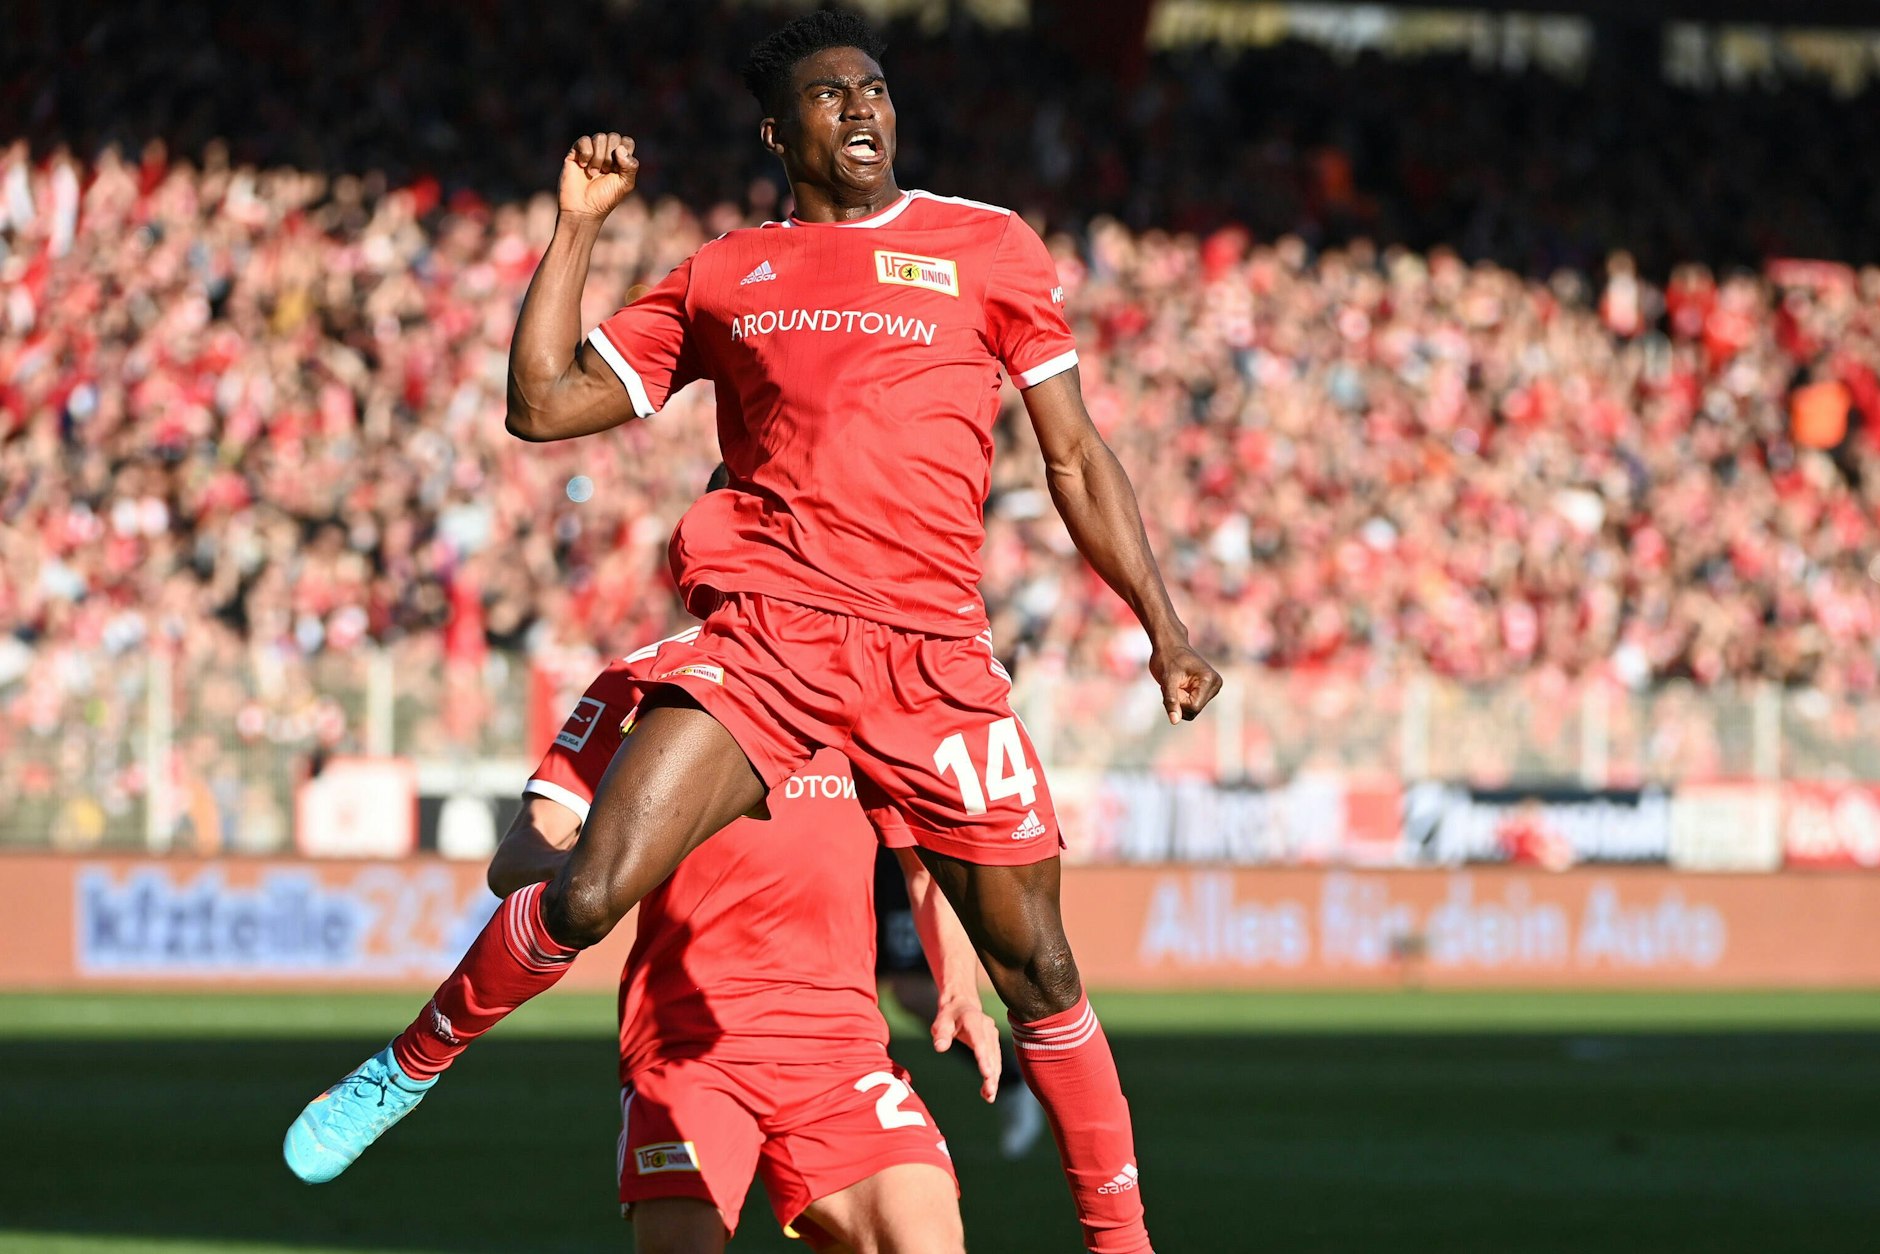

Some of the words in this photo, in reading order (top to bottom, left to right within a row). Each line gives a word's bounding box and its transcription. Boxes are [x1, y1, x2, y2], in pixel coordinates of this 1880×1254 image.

[740, 273, 777, 286] adidas
[921, 268, 951, 286] UNION
[731, 309, 937, 346] AROUNDTOWN
[932, 716, 1038, 816] 14
[1011, 824, 1046, 840] adidas
[1140, 872, 1308, 968] Alles
[1426, 875, 1569, 968] dein
[1576, 882, 1726, 968] Auto
